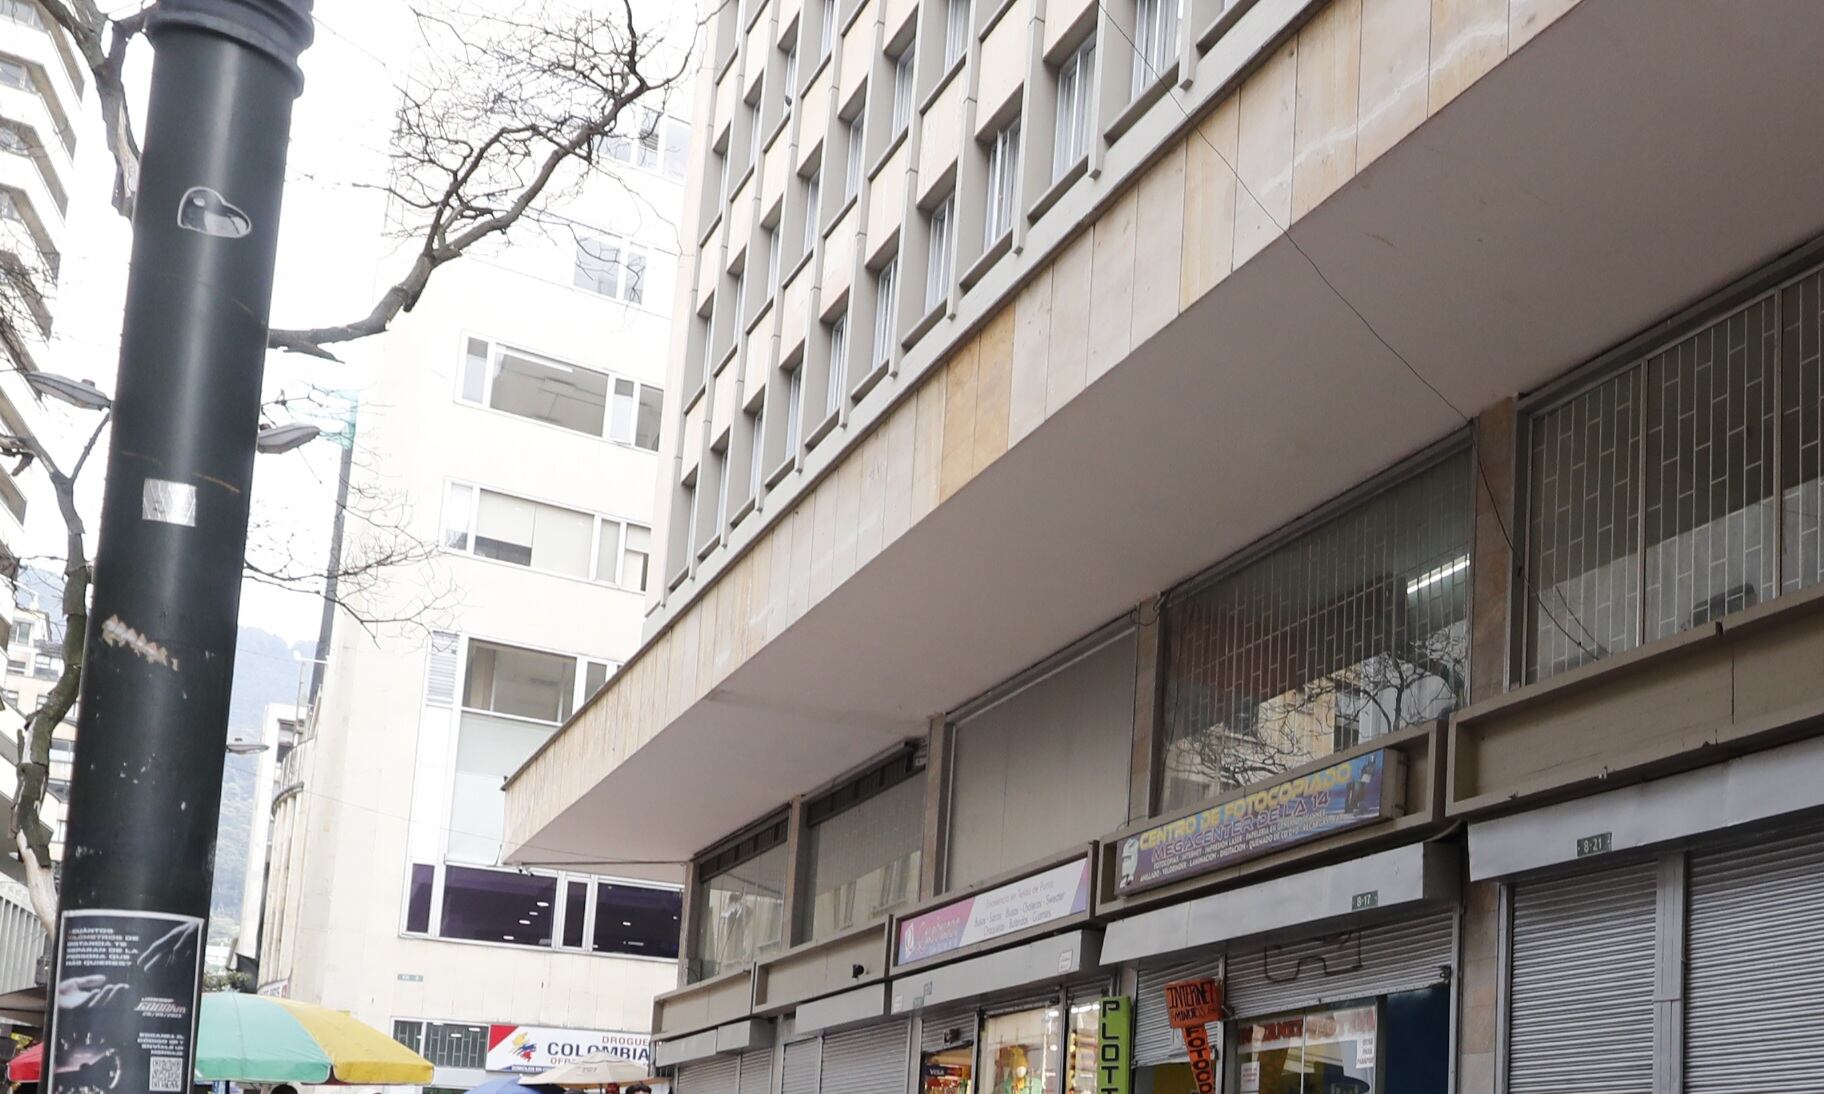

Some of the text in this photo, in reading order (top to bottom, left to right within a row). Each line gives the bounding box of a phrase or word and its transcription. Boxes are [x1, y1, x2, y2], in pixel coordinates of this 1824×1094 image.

[1140, 817, 1197, 850] CENTRO
[1200, 808, 1220, 827] DE
[1223, 763, 1353, 821] FOTOCOPIADO
[1152, 814, 1254, 862] MEGACENTER
[1256, 806, 1280, 828] DE
[1283, 799, 1307, 818] LA
[1312, 791, 1328, 809] 14
[1584, 839, 1602, 853] 8-21
[1356, 894, 1371, 907] 8-17
[1166, 981, 1215, 1009] INTERNET
[547, 1042, 650, 1061] COLOMBIA
